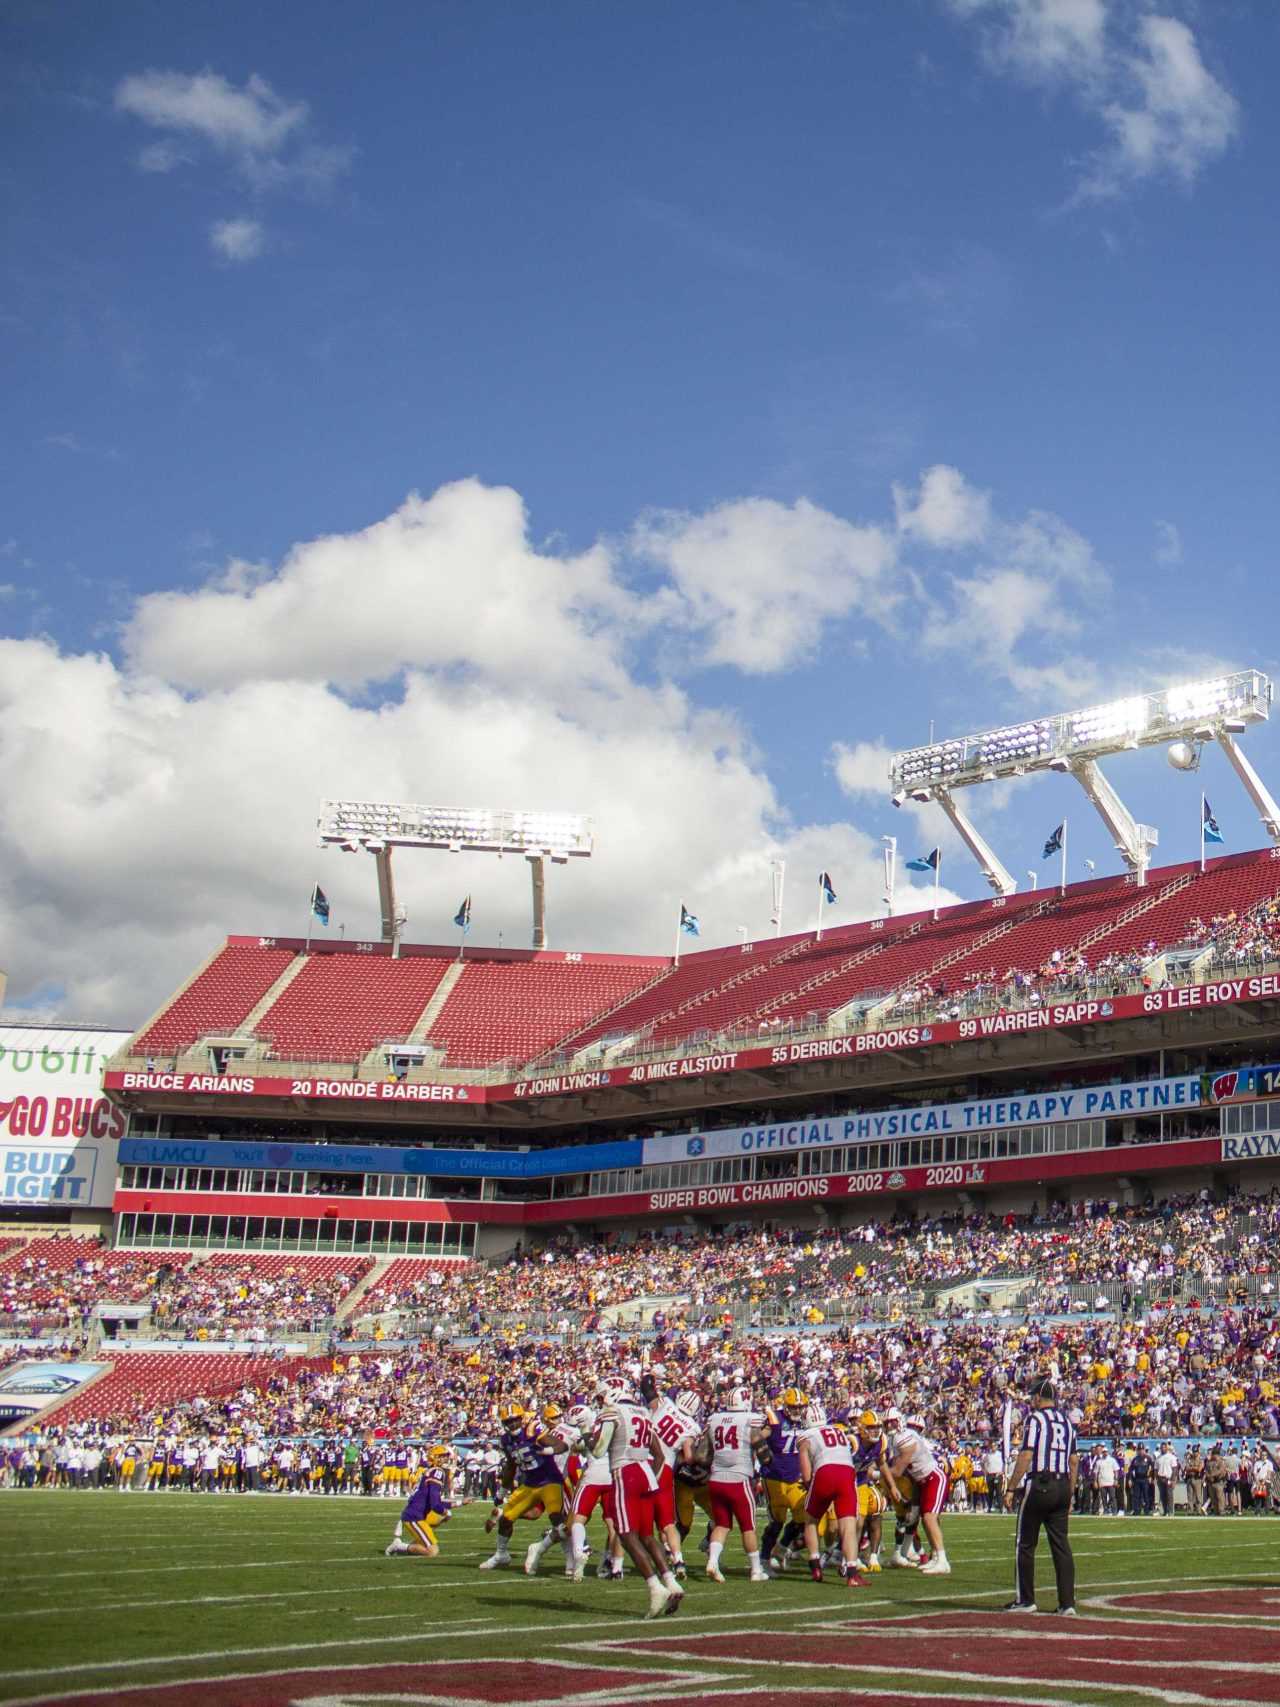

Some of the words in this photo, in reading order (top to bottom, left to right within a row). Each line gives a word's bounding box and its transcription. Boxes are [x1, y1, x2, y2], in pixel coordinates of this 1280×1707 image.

[991, 897, 1007, 910] 339
[869, 919, 885, 931] 340
[356, 942, 374, 953] 343
[564, 952, 584, 963] 342
[740, 943, 754, 954] 341
[1143, 993, 1163, 1012] 63
[1167, 988, 1201, 1008] LEE
[1205, 981, 1244, 1003] ROY
[959, 1020, 977, 1038] 99
[980, 1008, 1050, 1034] WARREN
[1053, 1002, 1099, 1024] SAPP
[771, 1047, 788, 1063] 55
[790, 1037, 853, 1061] DERRICK
[856, 1028, 919, 1051] BROOKS
[630, 1066, 645, 1081] 40
[647, 1060, 678, 1079] MIKE
[680, 1053, 737, 1075] ALSTOTT
[123, 1073, 184, 1090] BRUCE
[189, 1076, 255, 1093] ARIANS
[291, 1081, 311, 1095] 20
[316, 1081, 378, 1098] RONDÉ
[382, 1084, 454, 1100] BARBER
[514, 1083, 527, 1097] 47
[528, 1078, 560, 1095] JOHN
[562, 1072, 600, 1091] LYNCH
[9, 1095, 48, 1137] GO
[51, 1096, 126, 1139] BUCS
[741, 1122, 834, 1150] OFFICIAL
[844, 1109, 953, 1140] PHYSICAL
[964, 1095, 1074, 1127] THERAPY
[1086, 1080, 1200, 1114] PARTNER
[5, 1151, 76, 1175] BUD
[151, 1147, 207, 1163] LMCU
[459, 1157, 506, 1171] Official
[0, 1175, 87, 1200] IGHT
[847, 1173, 883, 1193] 2002
[926, 1166, 963, 1185] 2020
[650, 1190, 694, 1210] SUPER
[697, 1186, 739, 1206] BOWL
[742, 1178, 829, 1202] CHAMPIONS
[630, 1416, 651, 1448] 36
[656, 1414, 684, 1447] 96
[714, 1425, 739, 1451] 94
[818, 1428, 847, 1447] 68
[1050, 1422, 1066, 1449] R
